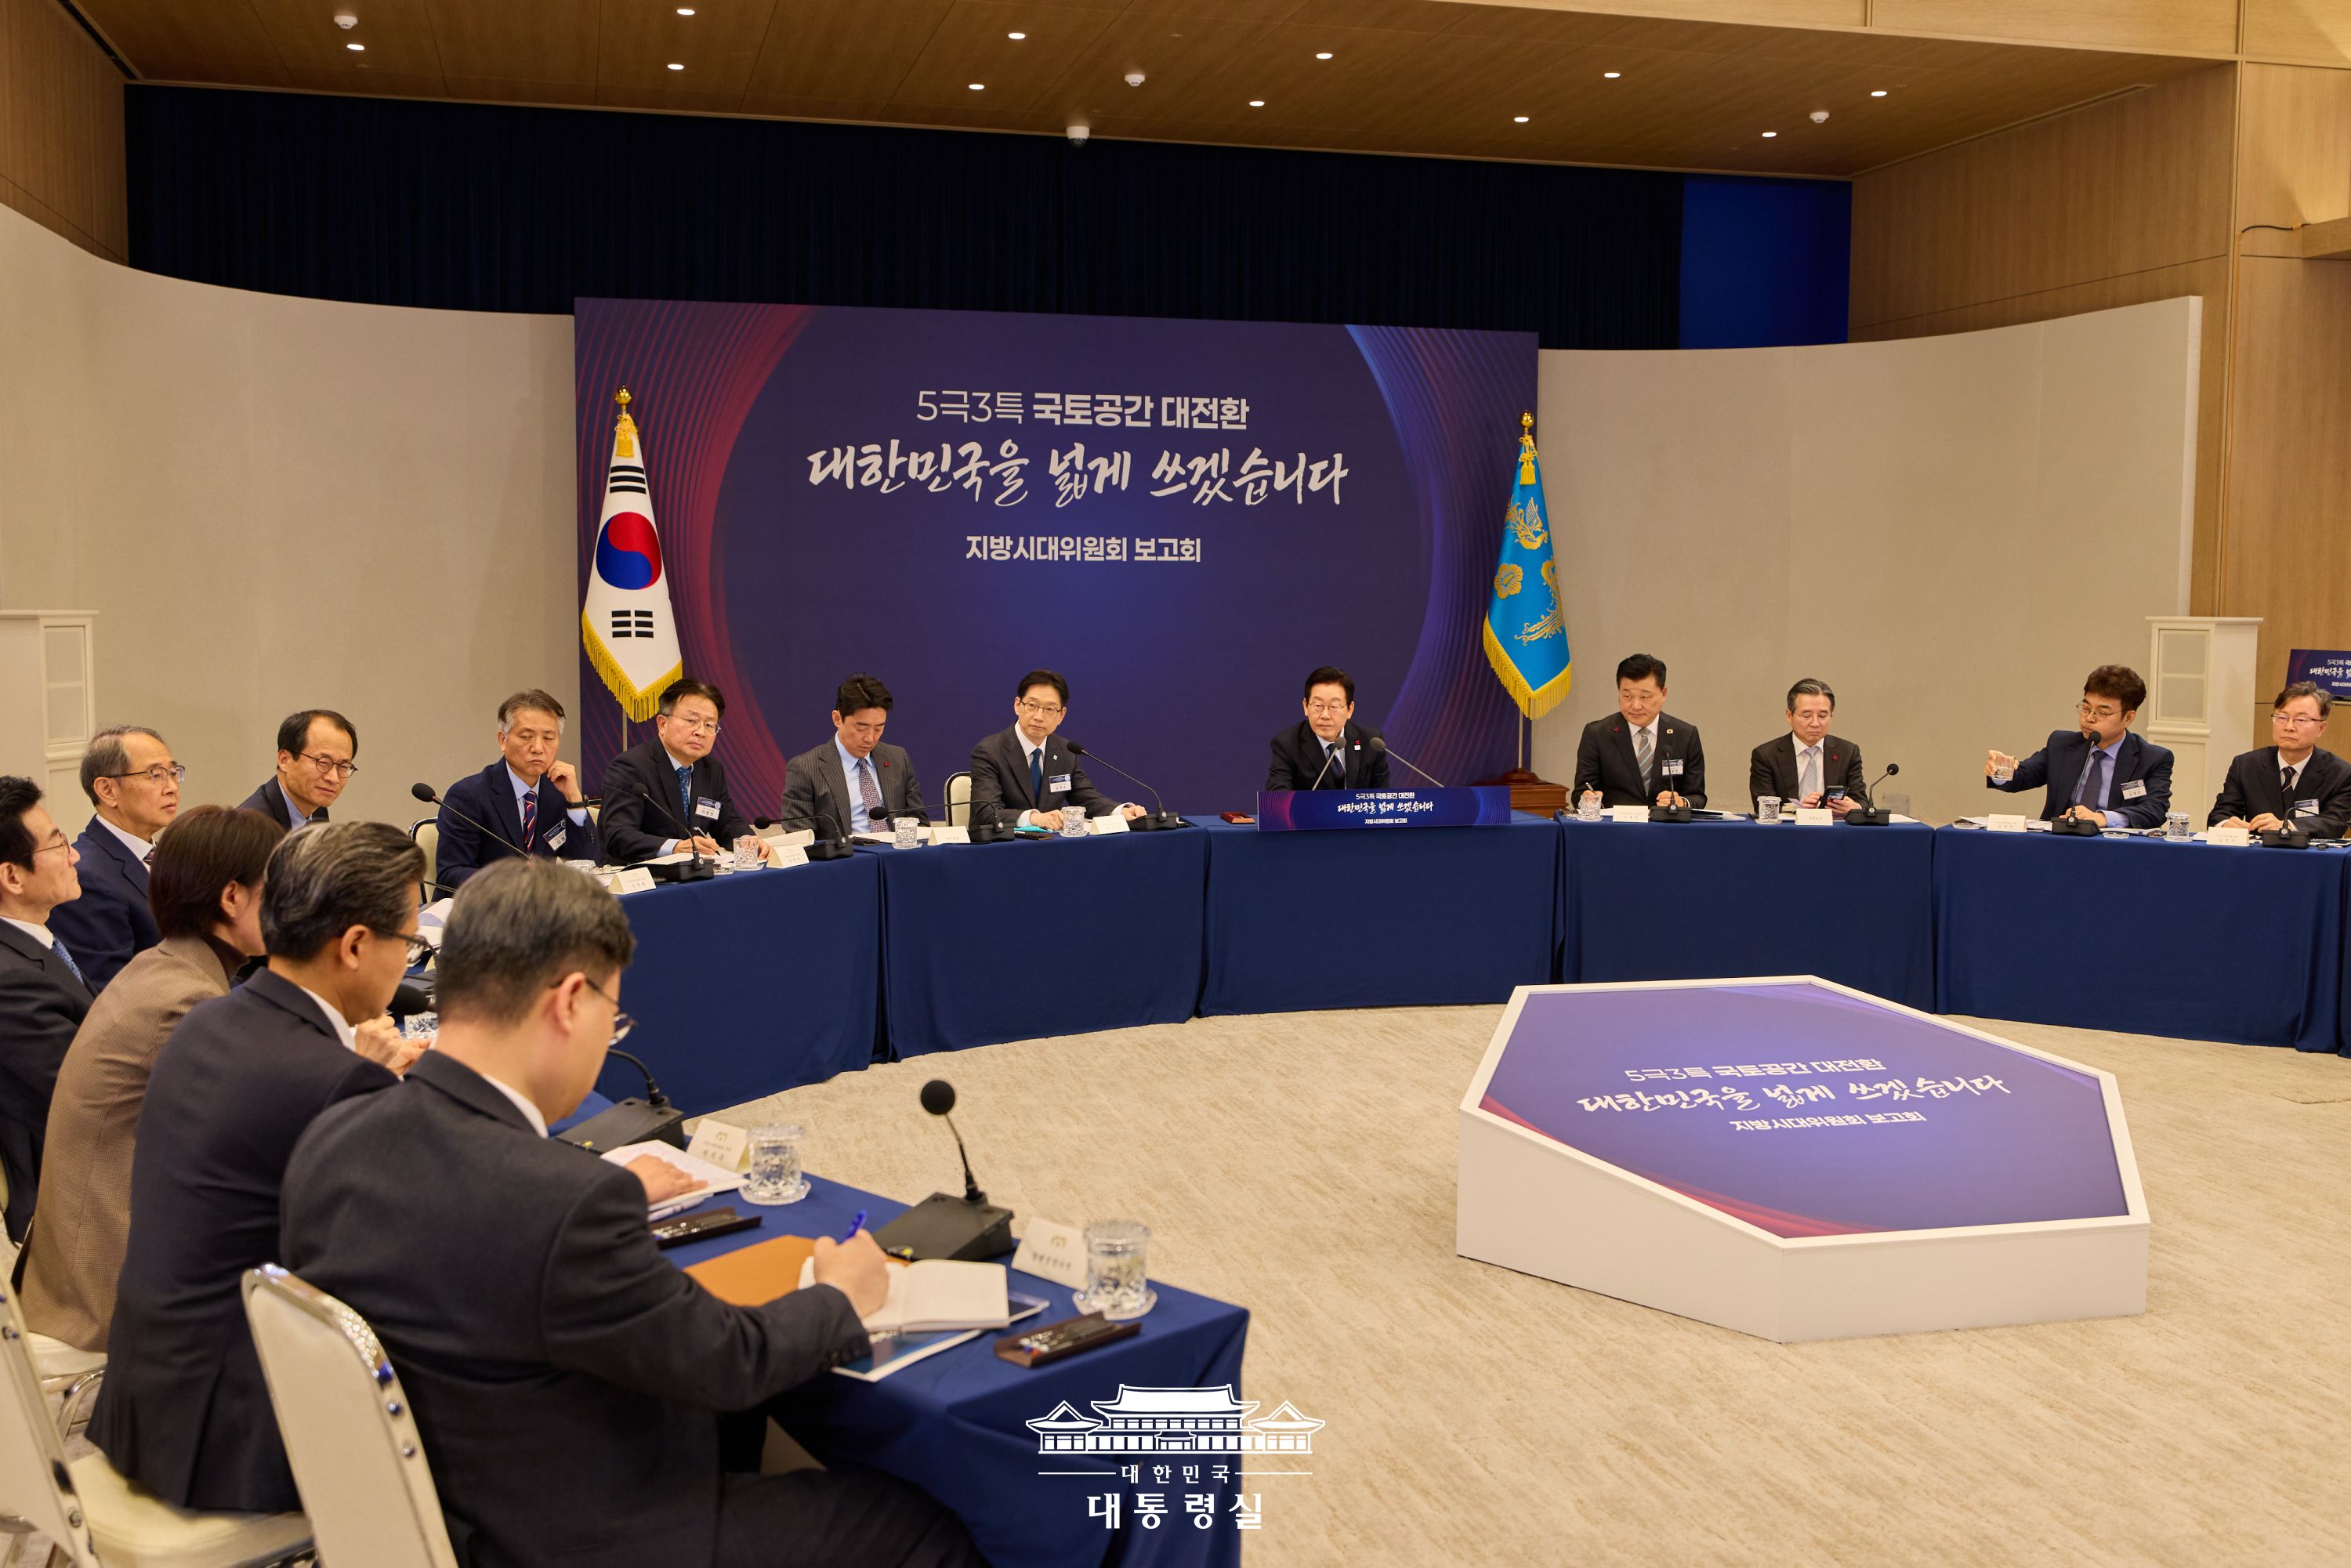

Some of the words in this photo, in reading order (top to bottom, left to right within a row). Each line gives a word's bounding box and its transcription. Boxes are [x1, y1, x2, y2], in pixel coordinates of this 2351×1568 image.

[916, 390, 1024, 425] 5극3특
[1032, 393, 1154, 428] 국토공간
[1161, 397, 1250, 430] 대전환
[806, 438, 1030, 507] 대한민국을
[1049, 442, 1132, 509] 넓게
[1150, 447, 1349, 506] 쓰겠습니다
[965, 535, 1128, 561] 지방시대위원회
[1134, 538, 1201, 563] 보고회
[1337, 801, 1377, 815] 대한민국을
[1378, 801, 1395, 815] 넓게
[1396, 800, 1434, 813] 쓰겠습니다
[1624, 1066, 1711, 1082] 5극3특
[1712, 1062, 1813, 1078] 국토공간
[1814, 1058, 1887, 1074] 대전환
[1576, 1086, 1761, 1114] 대한민국을
[1762, 1084, 1836, 1109] 넓게
[1849, 1074, 2012, 1101] 쓰겠습니다
[1729, 1114, 1867, 1132] 지방시대위원회
[1865, 1110, 1928, 1125] 보고회
